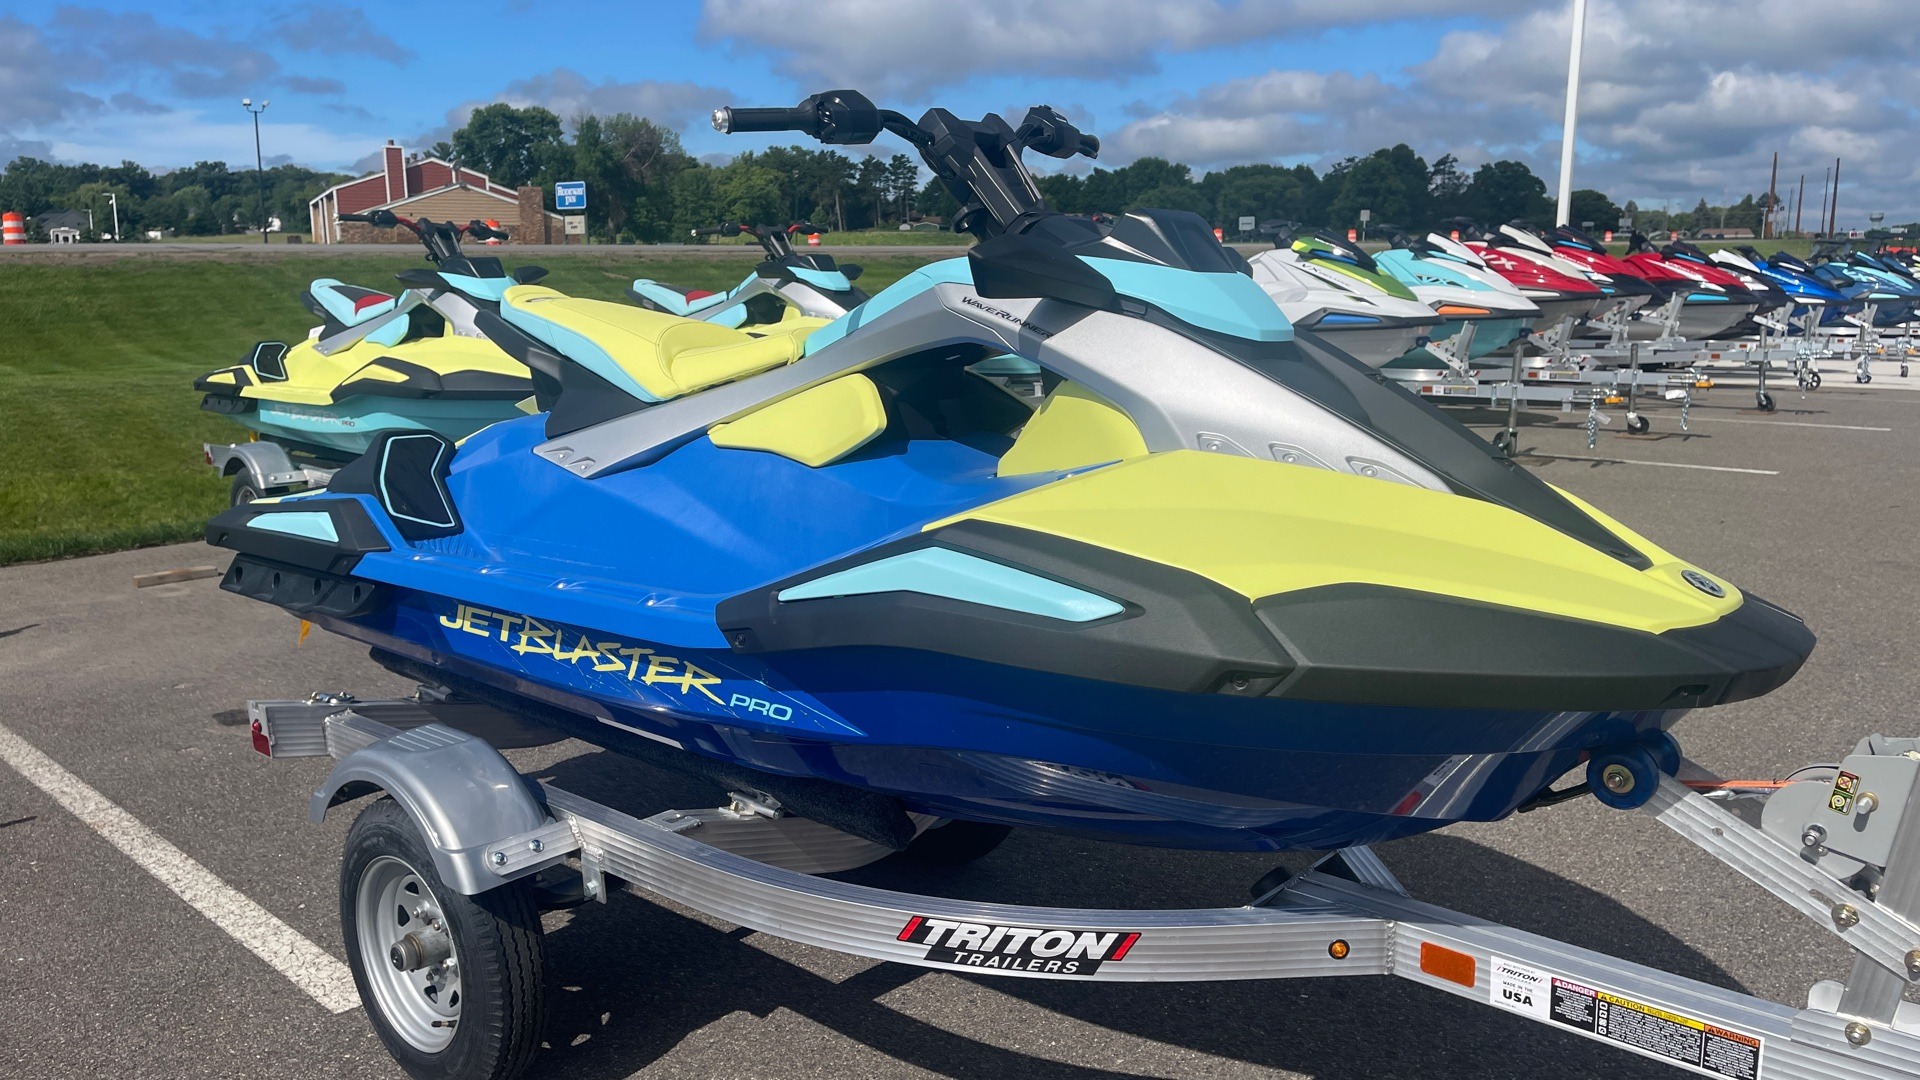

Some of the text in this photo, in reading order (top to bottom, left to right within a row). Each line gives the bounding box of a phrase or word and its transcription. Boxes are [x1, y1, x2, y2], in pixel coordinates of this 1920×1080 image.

[1301, 263, 1320, 273] VX
[1478, 250, 1518, 270] VX
[729, 693, 792, 721] PRO
[922, 918, 1119, 960] TRITON
[953, 951, 1080, 974] TRAILERS
[1501, 967, 1539, 982] TRITON
[1502, 980, 1516, 988] MADE
[1502, 988, 1533, 1007] USA
[1561, 981, 1596, 997] DANGER
[1608, 995, 1645, 1012] CAUTION
[1715, 1027, 1757, 1046] WARNING
